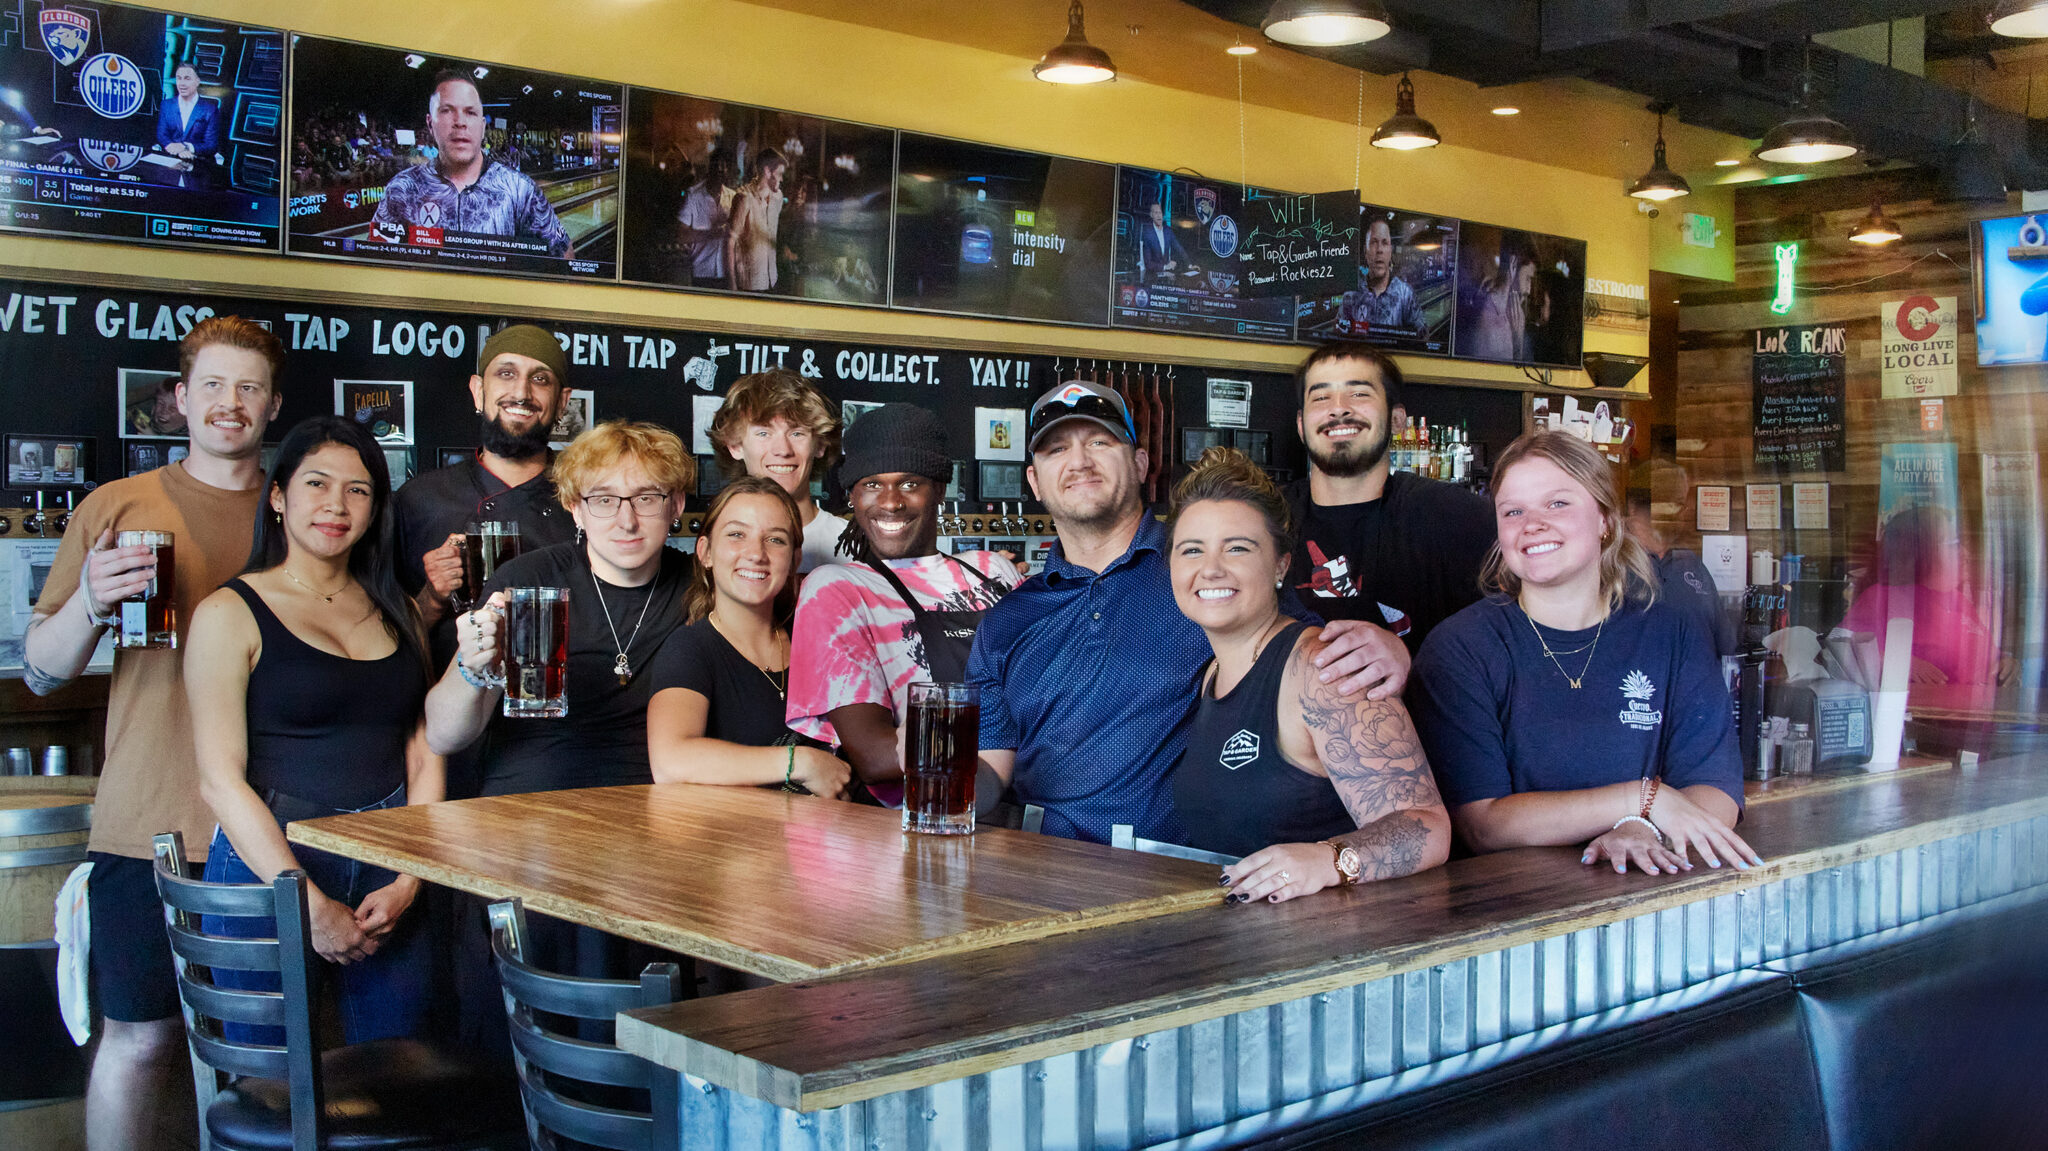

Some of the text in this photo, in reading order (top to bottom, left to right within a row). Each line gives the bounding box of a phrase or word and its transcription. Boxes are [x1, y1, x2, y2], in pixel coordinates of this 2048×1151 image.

[43, 12, 87, 28] FLORIDA
[89, 75, 137, 99] OILERS
[6, 160, 29, 169] FINAL
[36, 163, 60, 173] GAME
[14, 177, 34, 186] +100
[44, 180, 58, 189] 5.5
[41, 190, 60, 199] O/U
[69, 182, 93, 192] Total
[94, 186, 109, 194] set
[121, 188, 135, 197] 5.5
[135, 189, 149, 198] for
[289, 193, 327, 208] SPORTS
[1268, 195, 1316, 224] WIFI
[1017, 213, 1033, 223] NEW
[192, 224, 209, 232] BET
[211, 227, 246, 236] DOWNLOAD
[380, 222, 406, 233] PBA
[416, 229, 430, 237] BILL
[416, 237, 441, 245] O'NEILL
[1013, 229, 1066, 254] intensity
[1213, 229, 1235, 245] OILERS
[444, 236, 463, 244] LEADS
[463, 238, 483, 246] GROUP
[487, 239, 502, 247] WITH
[511, 242, 529, 250] AFTER
[532, 244, 548, 252] GAME
[1320, 239, 1350, 258] Friends
[1012, 250, 1035, 267] dial
[1280, 265, 1335, 282] Rockies22
[1585, 277, 1645, 300] ESTROOM
[1150, 294, 1179, 303] PANTHERS
[284, 312, 350, 353] TAP
[372, 319, 465, 359] LOGO
[623, 335, 677, 370] TAP
[734, 342, 790, 375] TILT
[800, 347, 823, 379] &
[835, 349, 941, 385] COLLECT.
[1884, 340, 1954, 354] LONG LIVE
[1819, 358, 1830, 369] $5
[1884, 352, 1954, 369] LOCAL
[1905, 374, 1934, 386] Coors
[354, 390, 391, 412] CAPELLA
[1763, 395, 1794, 406] Alaskan
[1785, 405, 1801, 414] IPA
[1761, 416, 1782, 426] Avery
[1754, 426, 1773, 437] Avery
[1894, 458, 1944, 472] ALL IN ONE
[1894, 471, 1945, 483] PARTY PACK
[1569, 677, 1582, 689] M
